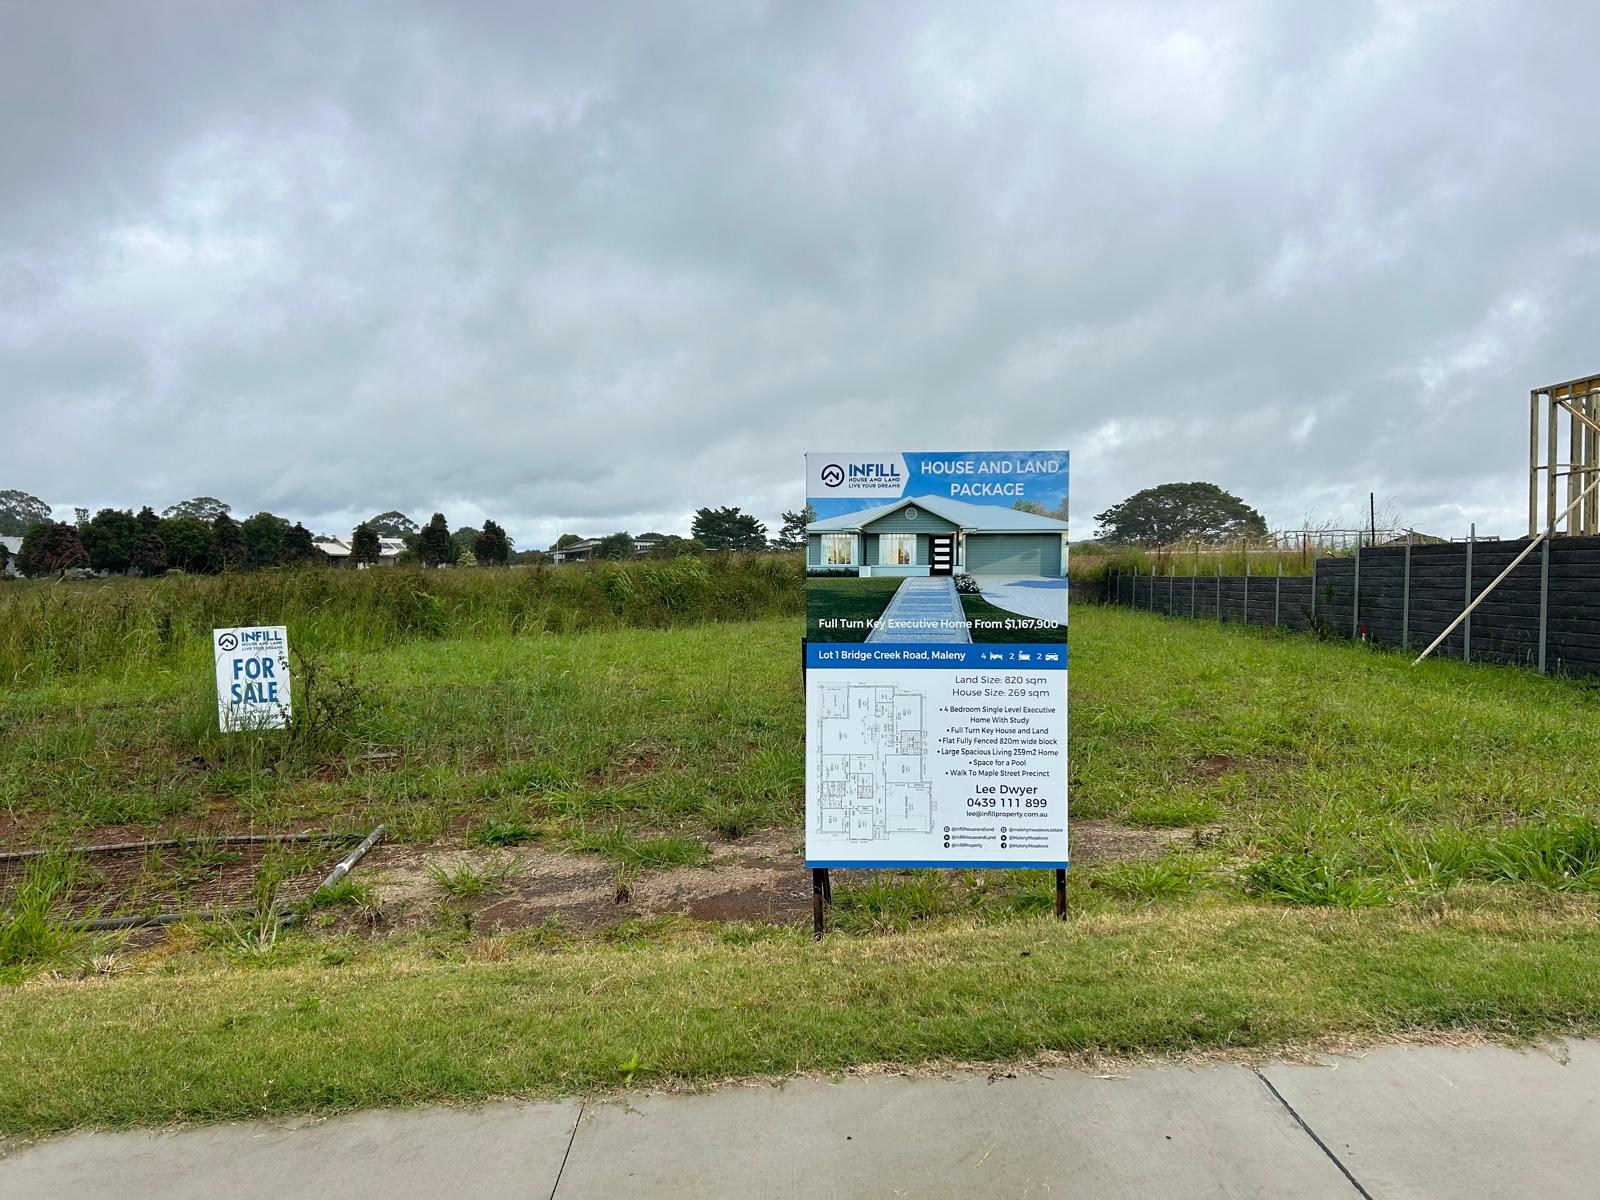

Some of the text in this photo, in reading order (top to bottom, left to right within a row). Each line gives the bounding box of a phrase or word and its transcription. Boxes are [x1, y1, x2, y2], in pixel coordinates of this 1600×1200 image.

[849, 464, 900, 476] INFILL
[921, 461, 1059, 474] HOUSE AND LAND
[950, 483, 1024, 496] PACKAGE
[819, 618, 1058, 631] Full Turn Key Executive Home From $1,167,900
[241, 631, 282, 642] INFILL
[818, 650, 966, 662] Lot 1 Bridge Creek Road, Maleny
[232, 657, 275, 680] FOR
[955, 676, 978, 684] Land
[980, 676, 1002, 684] Size:
[1004, 676, 1023, 684] 820
[231, 682, 279, 704] SALE
[984, 689, 1006, 697] Size:
[961, 748, 991, 756] Spacious
[993, 748, 1012, 756] Living
[976, 785, 1038, 796] Lee Dwyer
[967, 798, 1047, 808] 0439 111 899
